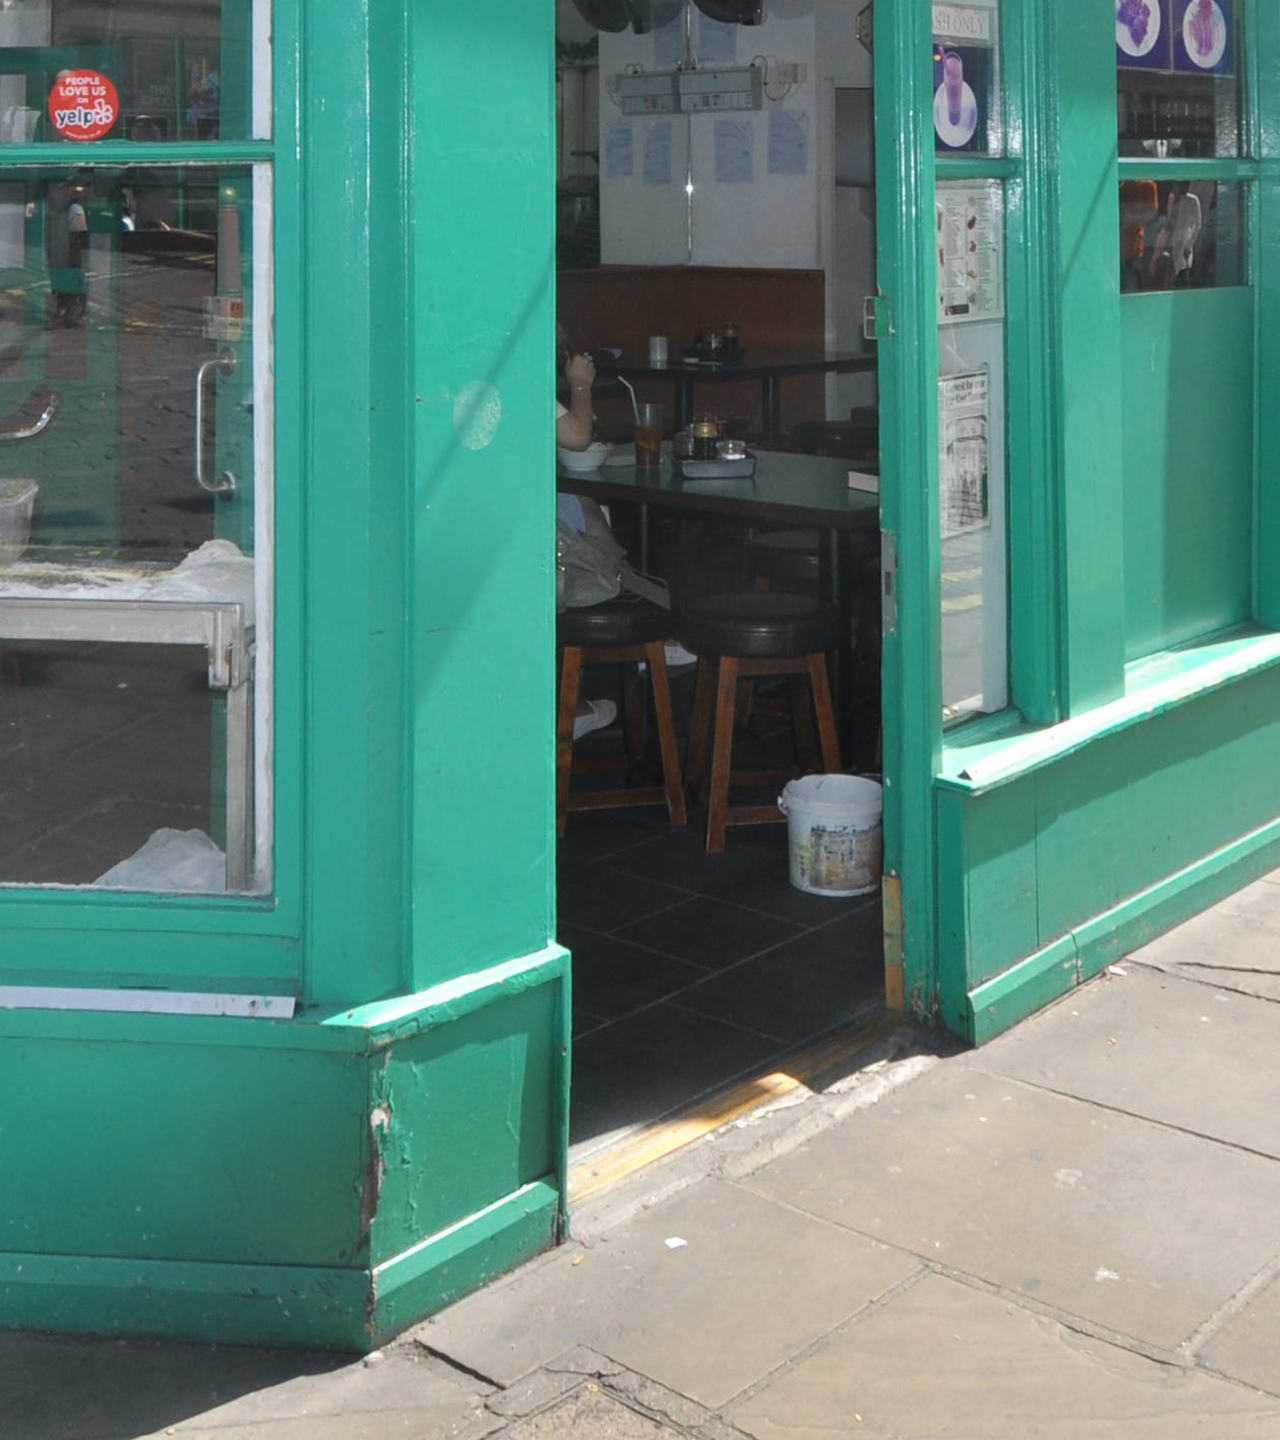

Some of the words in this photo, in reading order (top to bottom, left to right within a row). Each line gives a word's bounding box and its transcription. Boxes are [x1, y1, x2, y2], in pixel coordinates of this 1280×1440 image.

[953, 15, 985, 34] ONLY
[65, 77, 100, 85] PEOPLE
[59, 86, 89, 96] LOVE
[91, 86, 106, 95] US
[57, 107, 93, 127] yelp
